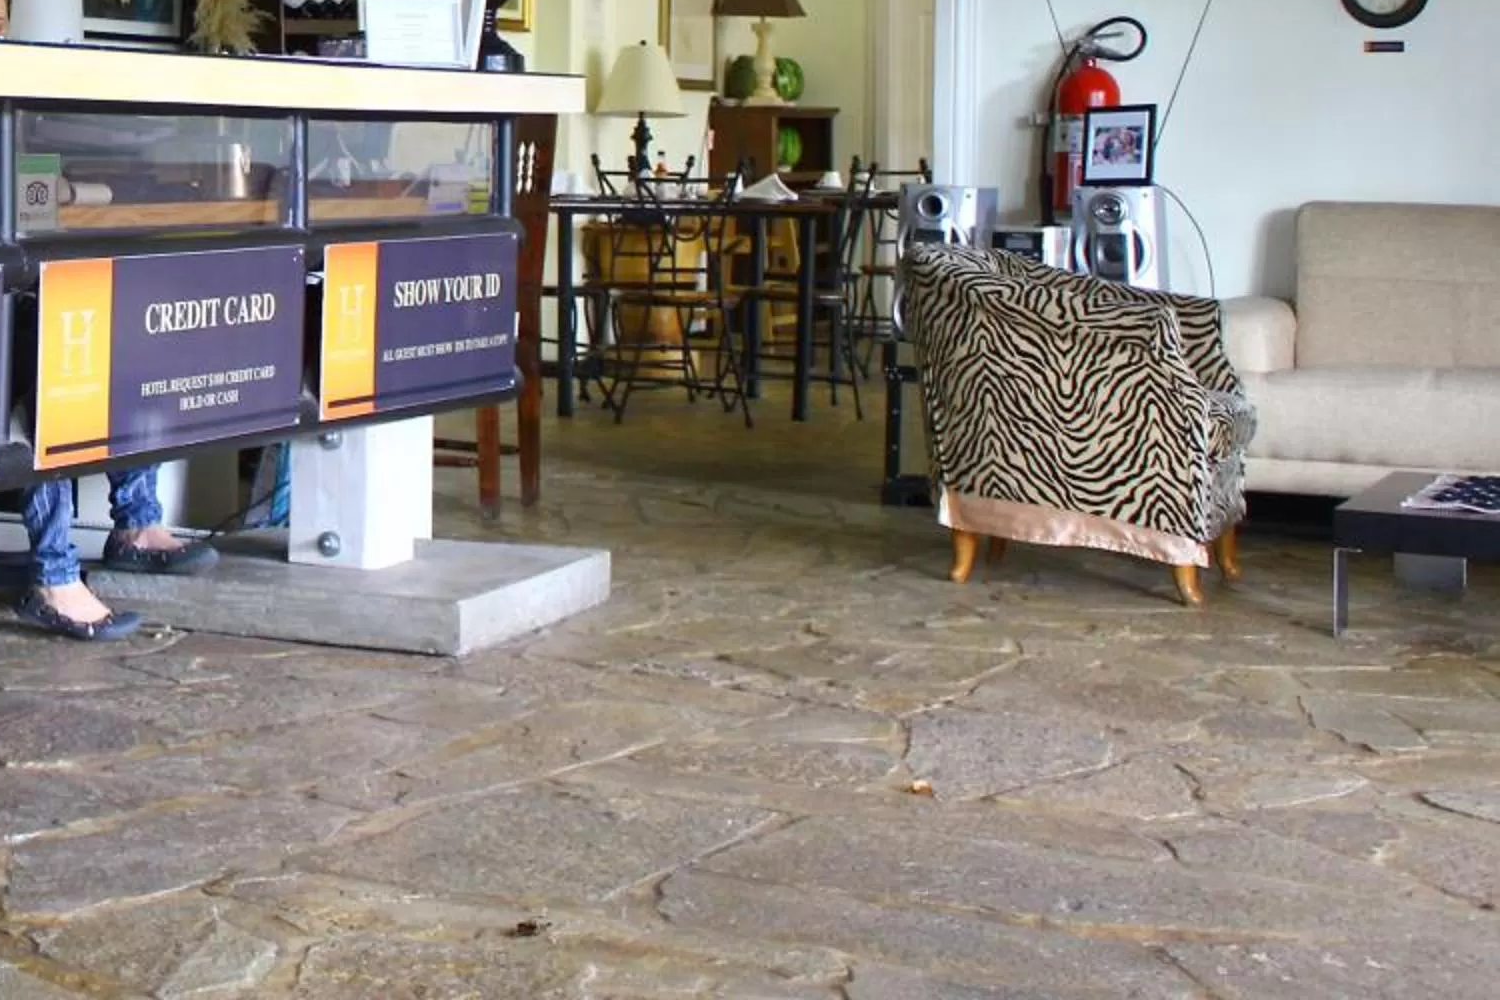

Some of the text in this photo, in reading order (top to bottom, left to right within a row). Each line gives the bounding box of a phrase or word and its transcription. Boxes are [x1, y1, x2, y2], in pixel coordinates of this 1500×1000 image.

[393, 272, 501, 308] SHOW YOUR ID
[145, 292, 276, 335] CREDIT CARD
